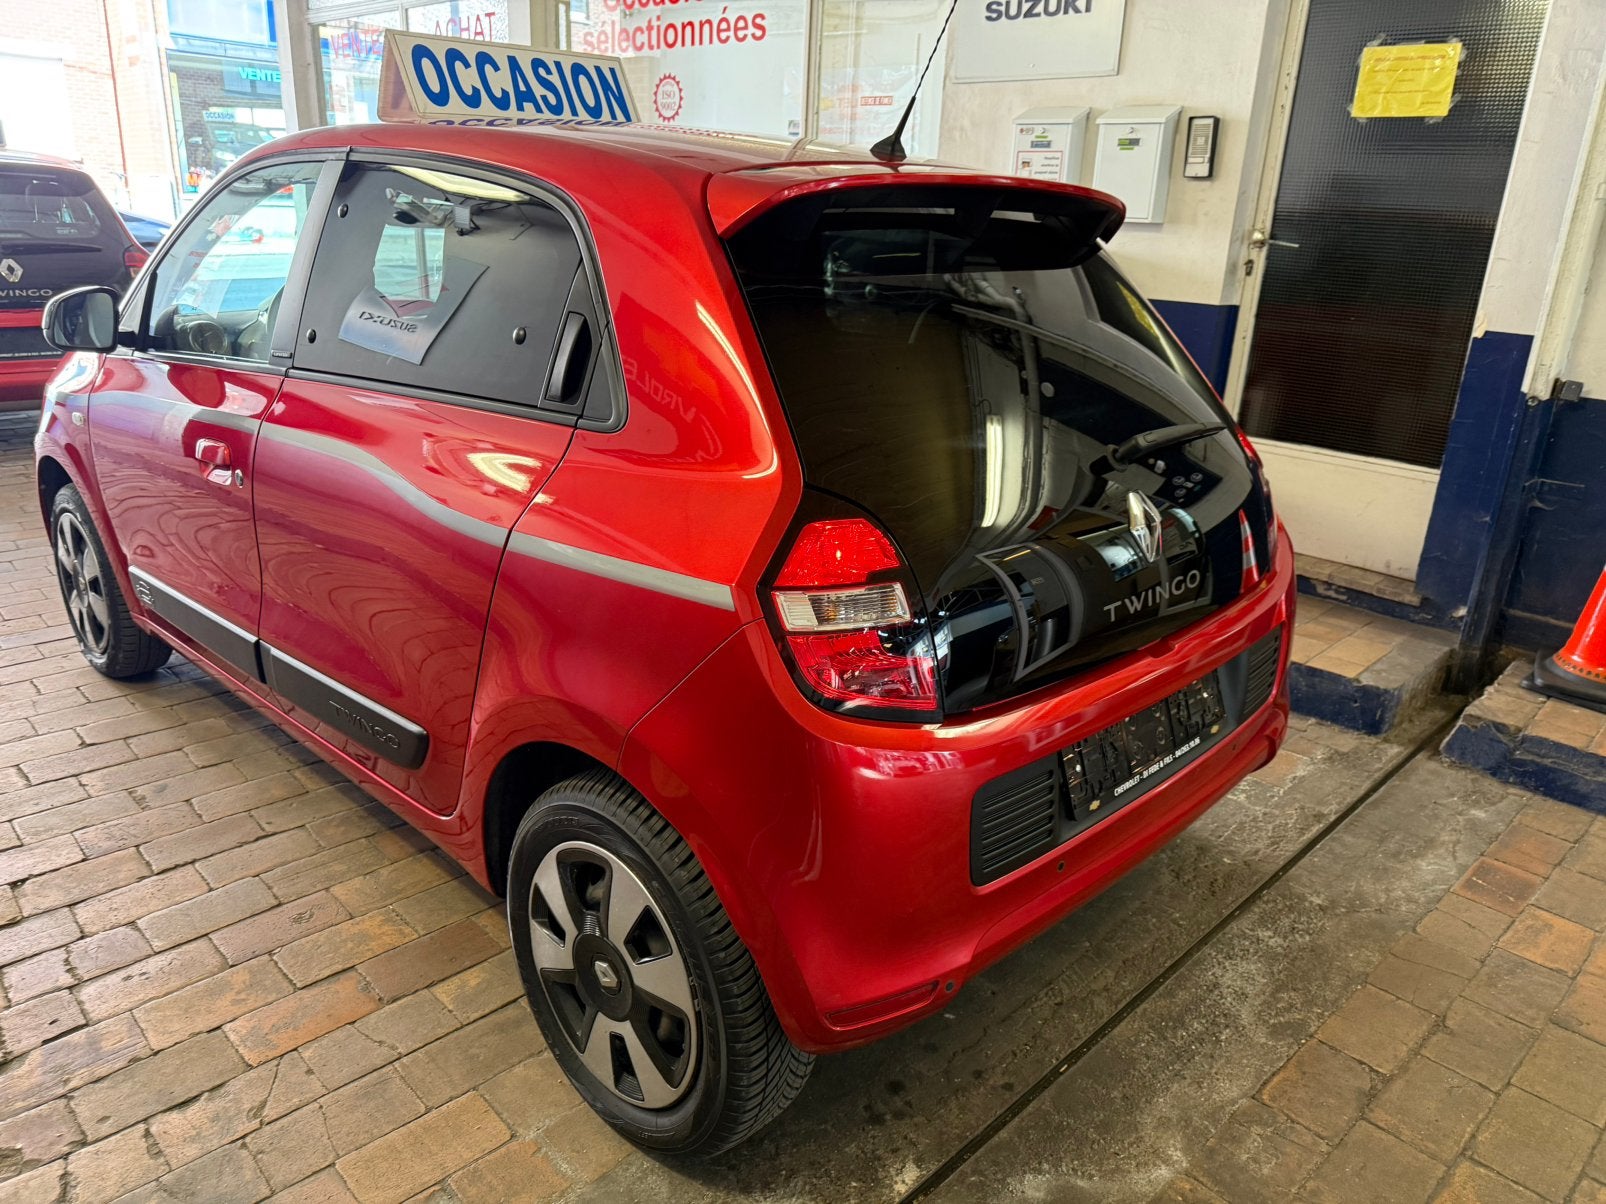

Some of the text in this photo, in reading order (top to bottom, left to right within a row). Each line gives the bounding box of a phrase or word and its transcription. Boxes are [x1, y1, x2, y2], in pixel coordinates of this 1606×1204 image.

[985, 0, 1093, 22] SUZUKI
[434, 12, 496, 42] ACHAT
[582, 6, 767, 53] sélectionnées
[238, 66, 281, 83] VENTE
[411, 43, 632, 123] OCCASION
[662, 90, 676, 100] ISO
[1104, 569, 1201, 623] TWINGO
[329, 700, 400, 749] TWINGO
[1114, 774, 1141, 797] CHEVROLET
